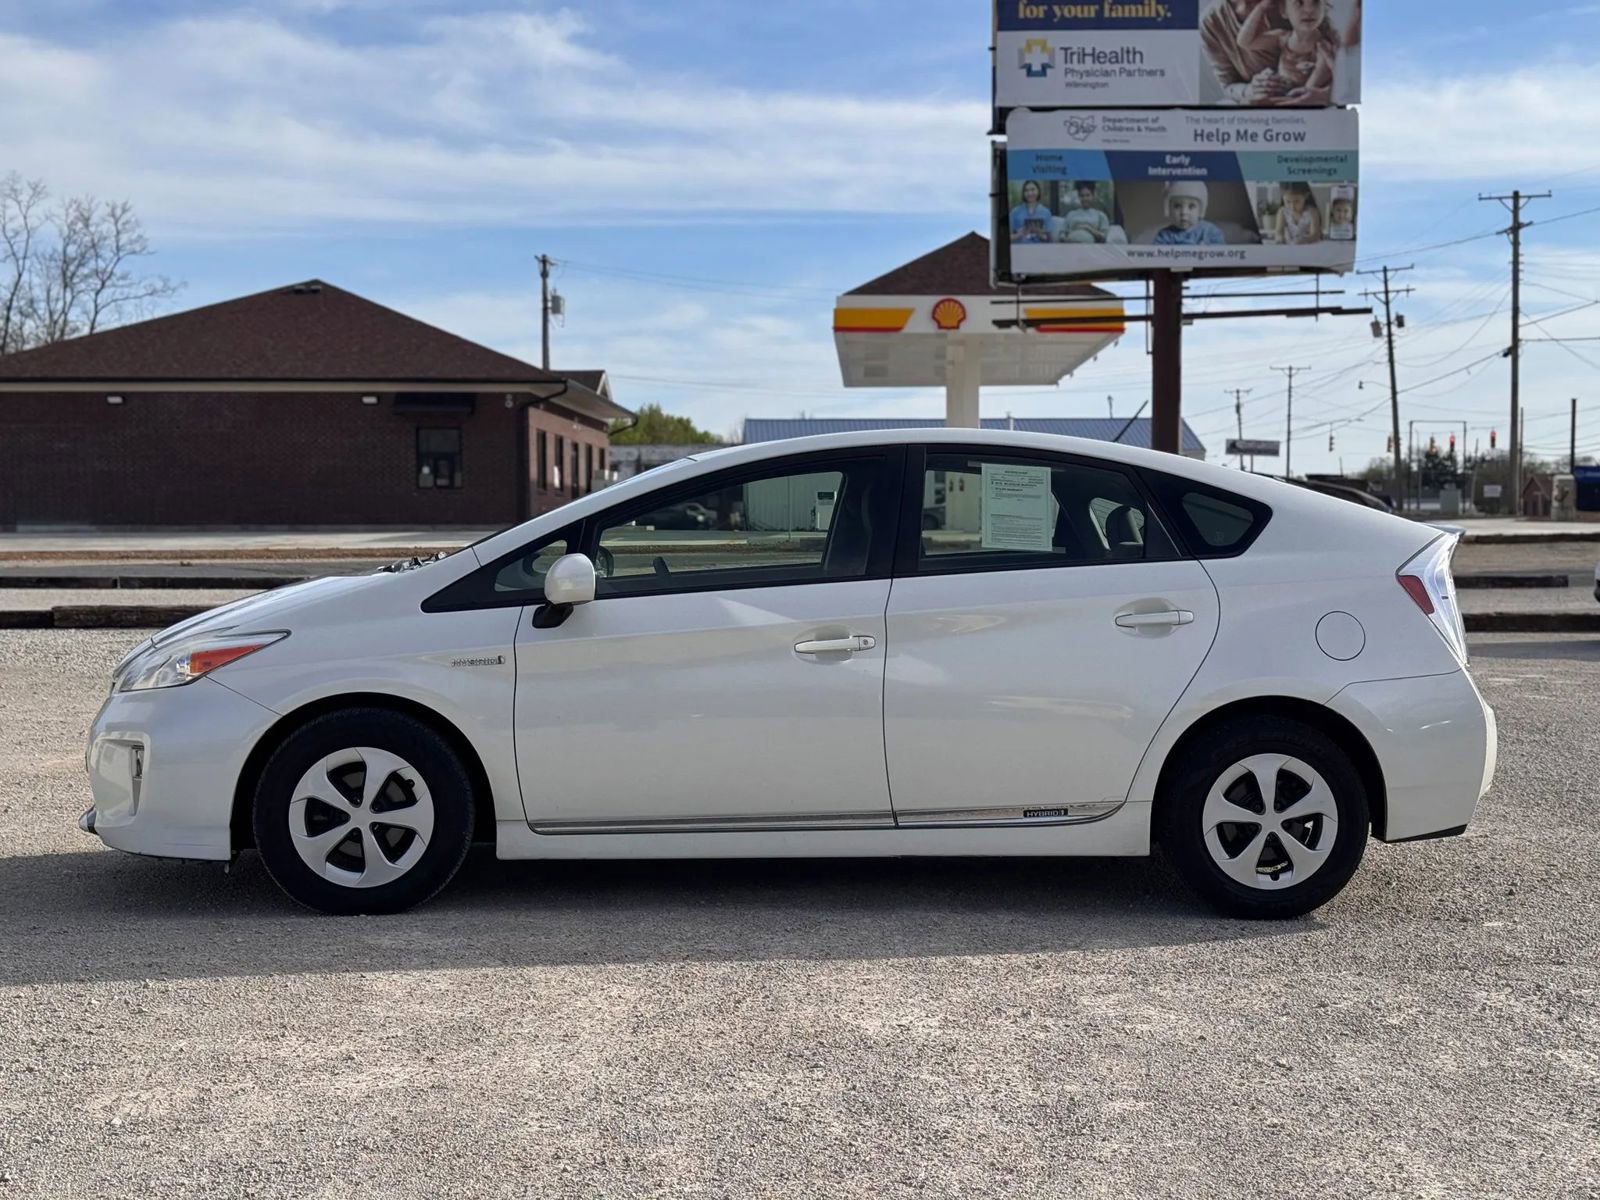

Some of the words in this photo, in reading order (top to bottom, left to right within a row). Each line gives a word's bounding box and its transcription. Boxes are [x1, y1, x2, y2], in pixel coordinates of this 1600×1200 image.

[1018, 0, 1048, 18] for
[1053, 3, 1099, 22] your
[1104, 0, 1172, 22] family.
[1060, 47, 1144, 65] TriHealth
[1064, 67, 1116, 80] Physician
[1119, 68, 1166, 78] Partners
[1102, 116, 1149, 125] Department
[1151, 116, 1160, 124] of
[1185, 116, 1199, 124] The
[1202, 116, 1225, 124] heart
[1227, 116, 1236, 124] of
[1236, 116, 1270, 126] thriving
[1102, 125, 1135, 133] Children
[1144, 125, 1167, 133] Youth
[1193, 128, 1231, 145] Help
[1236, 129, 1259, 142] Me
[1263, 128, 1306, 143] Grow
[1035, 153, 1063, 161] Home
[1165, 155, 1191, 166] Early
[1277, 154, 1348, 165] Developmental
[1032, 165, 1067, 176] Visiting
[1148, 166, 1208, 176] Intervention
[1287, 166, 1337, 176] Screenings
[1127, 248, 1247, 260] www.helpmegrow.org
